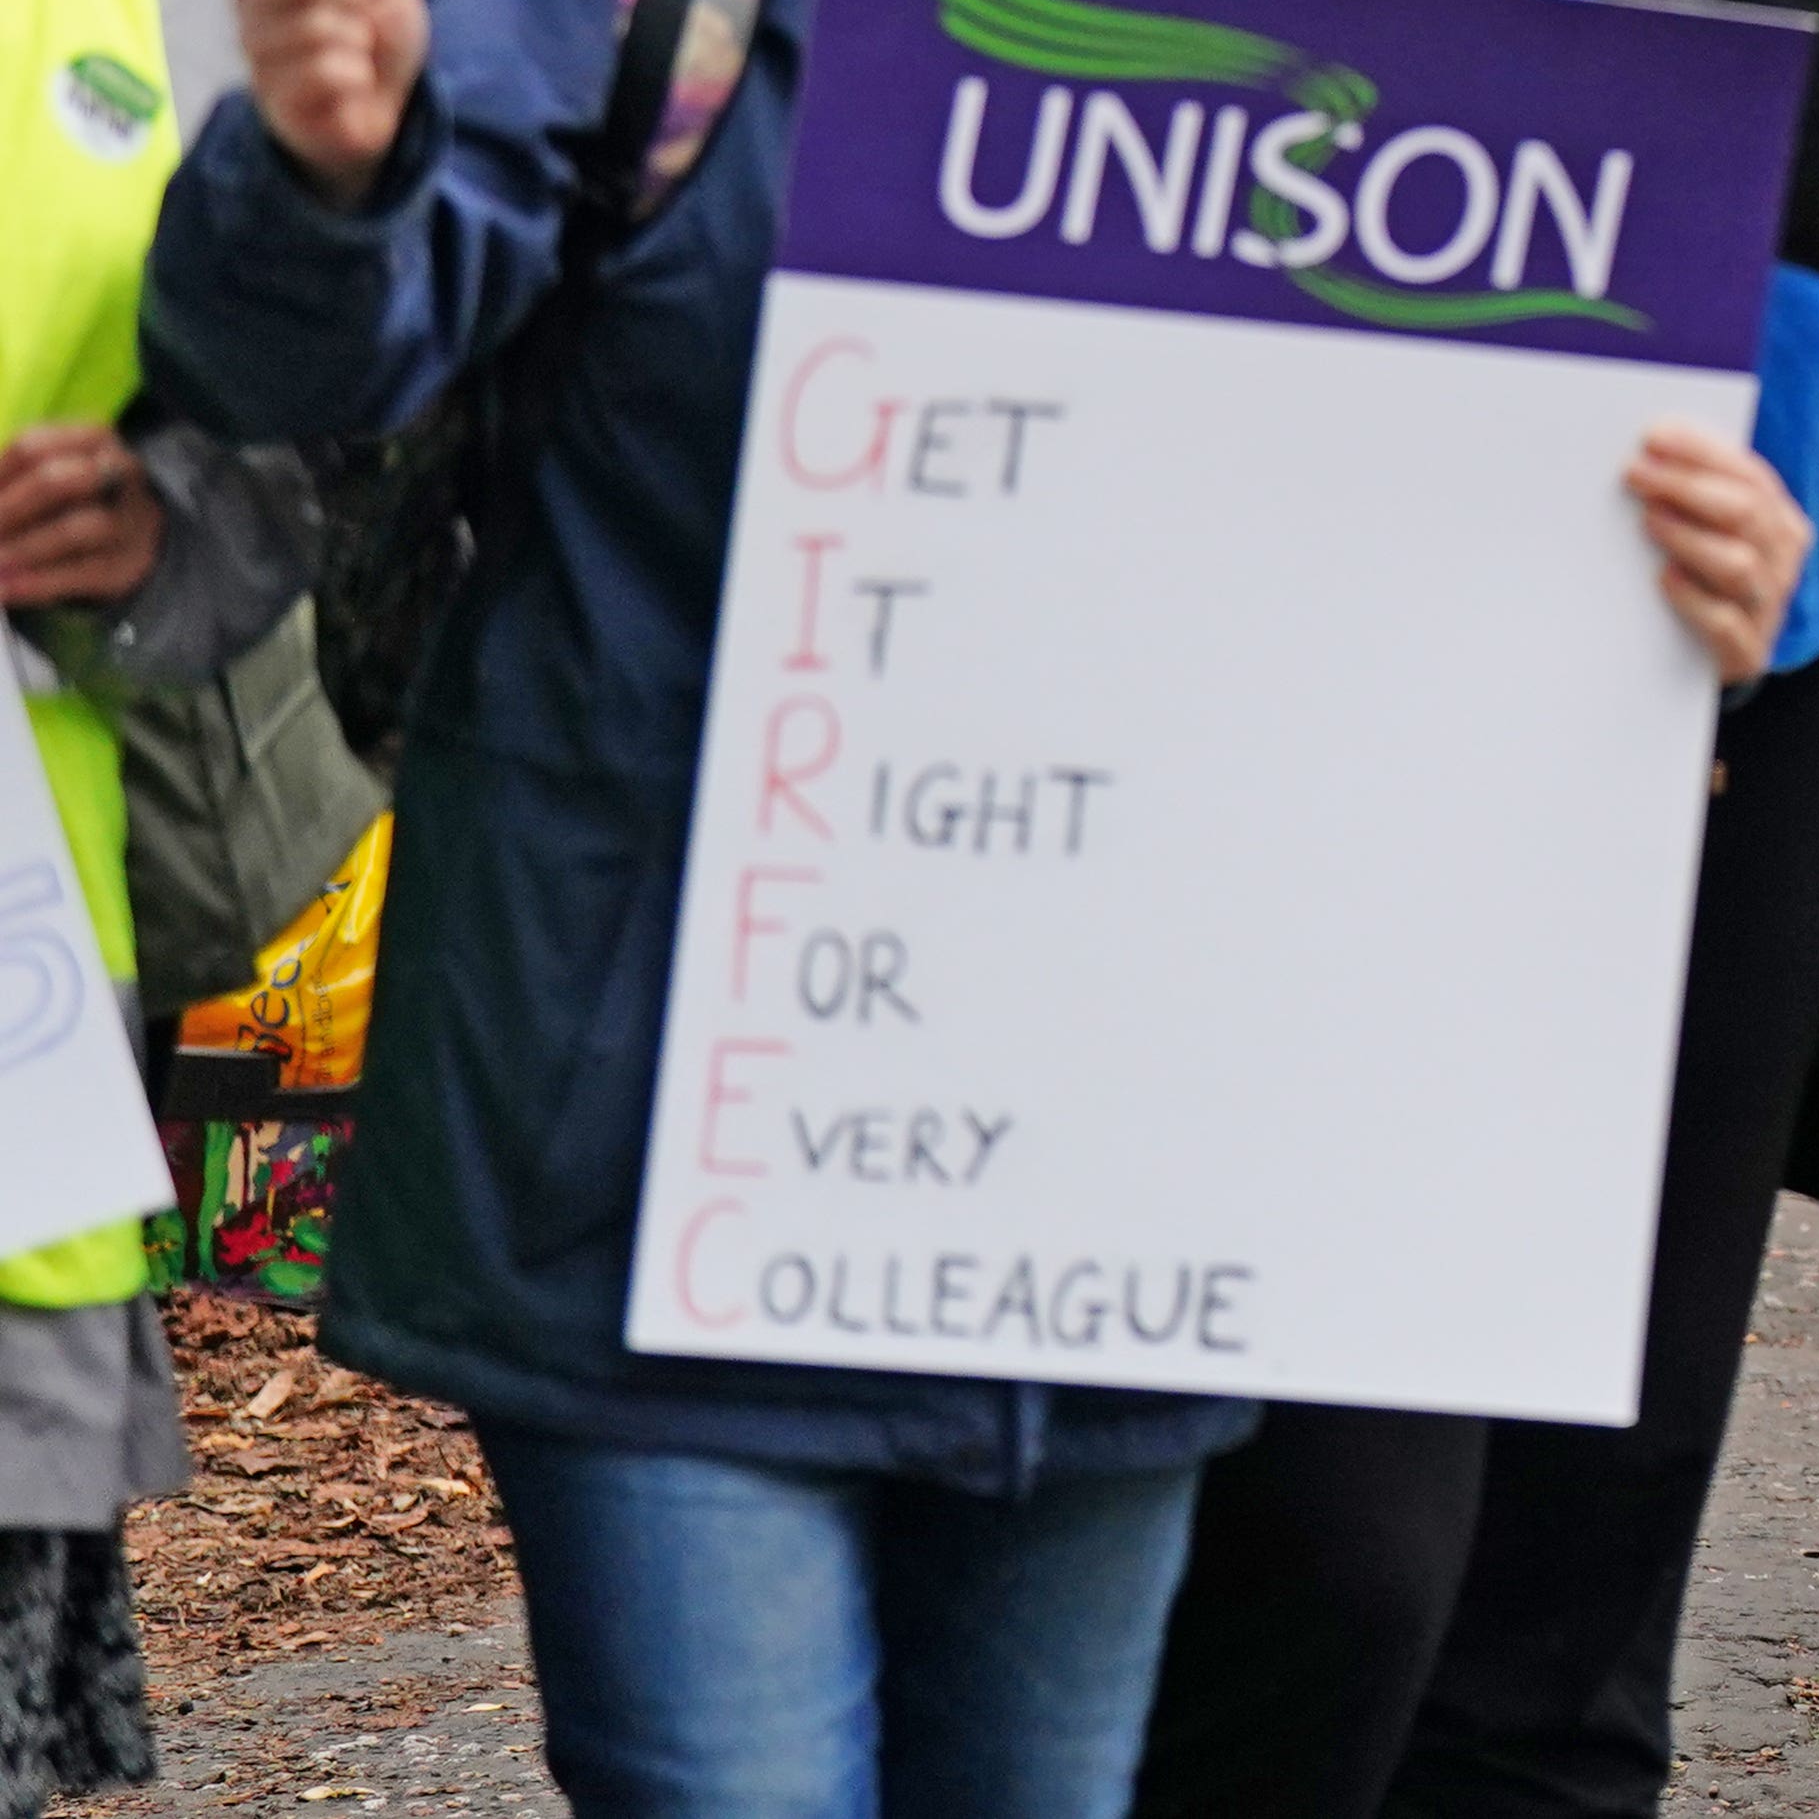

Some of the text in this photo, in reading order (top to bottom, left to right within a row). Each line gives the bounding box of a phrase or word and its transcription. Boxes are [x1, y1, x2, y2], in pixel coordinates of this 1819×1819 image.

[937, 76, 1633, 300] UNISON
[780, 335, 1066, 500] GET
[780, 533, 930, 679] IT
[756, 693, 1115, 859] RIGHT
[728, 865, 922, 1030] FOR
[697, 1039, 1015, 1186] EVERY
[674, 1198, 1258, 1355] COLLEAGUE
